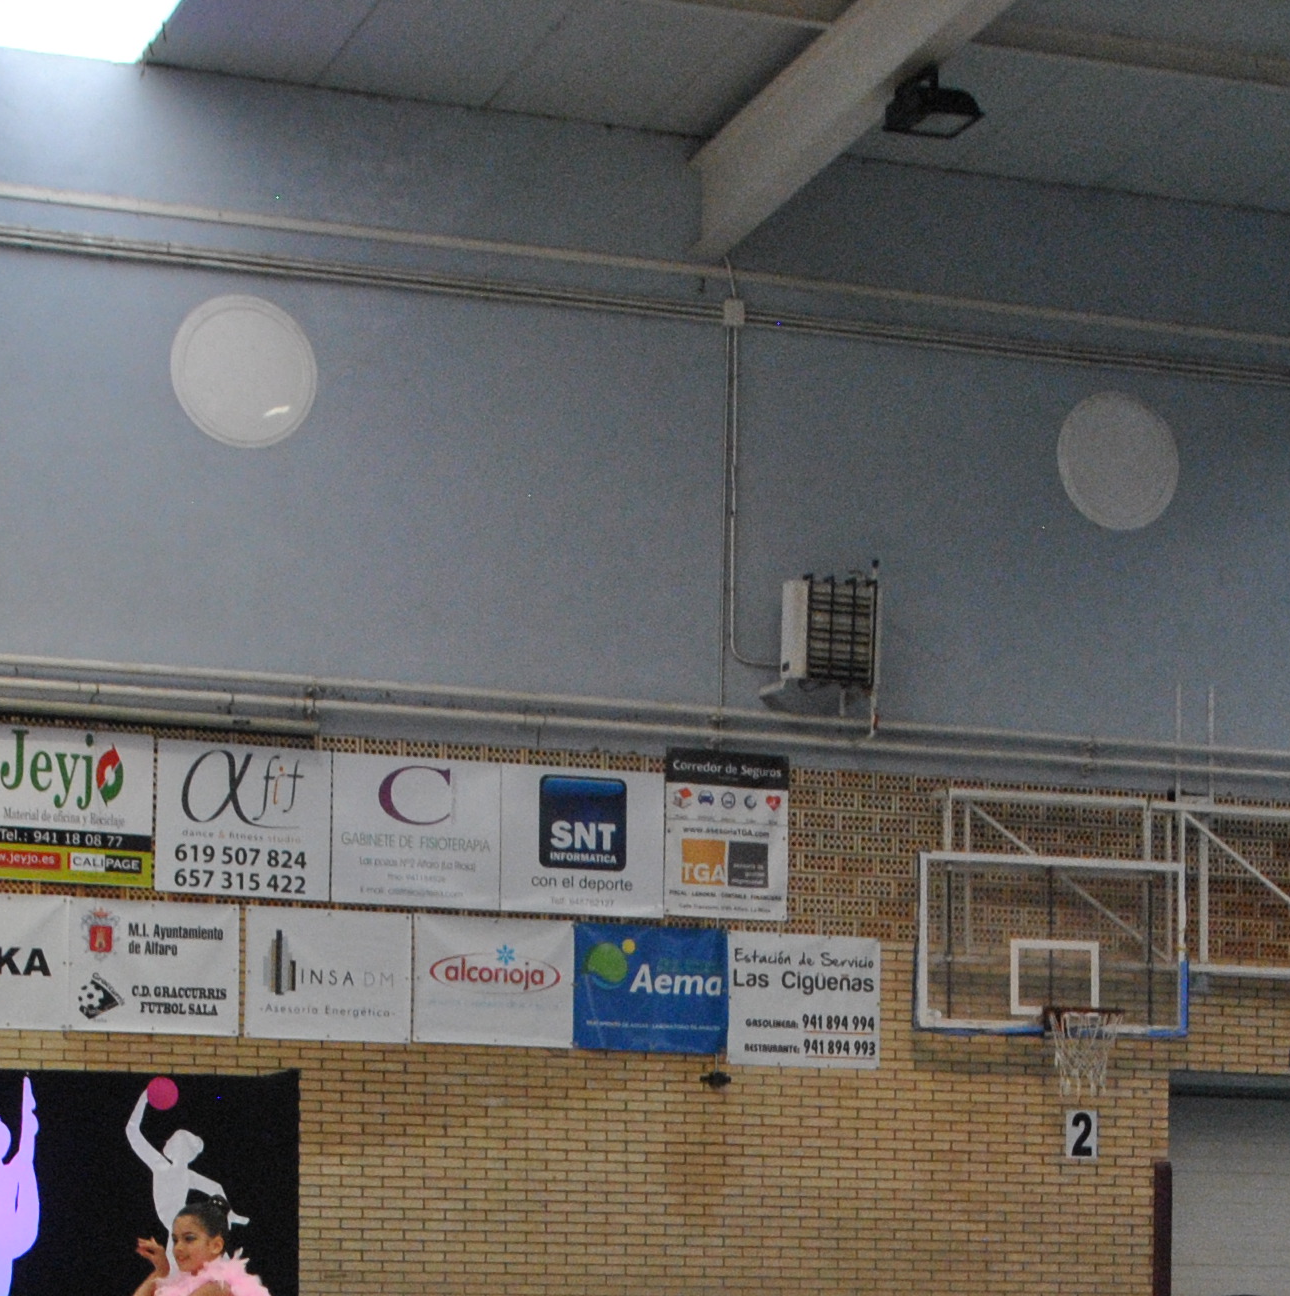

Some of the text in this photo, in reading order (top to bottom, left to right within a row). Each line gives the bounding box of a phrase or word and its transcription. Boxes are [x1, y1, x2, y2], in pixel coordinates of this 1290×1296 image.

[0, 729, 124, 810] Jeyjo
[673, 760, 782, 779] Corredor de Seguros
[3, 806, 38, 822] Material
[41, 810, 51, 822] de
[90, 813, 125, 828] Reciclaje
[34, 830, 57, 844] 941
[65, 833, 80, 845] 18
[85, 834, 101, 846] 08
[107, 835, 123, 847] 77
[341, 831, 491, 852] GABINETE DE FISIOTERAPIA
[550, 820, 616, 851] SNT
[175, 844, 307, 869] 619 507 824
[174, 868, 306, 895] 657 315 422
[683, 862, 727, 883] TGA
[531, 876, 633, 893] con el deporte
[128, 922, 223, 941] M.I. Ayuntamiento
[128, 940, 178, 956] de Alfaro
[734, 948, 874, 969] Estación de Servicio
[630, 963, 722, 996] Aema
[733, 969, 874, 995] Las Cigüeñas
[132, 985, 227, 1000] C.D. GRACCURRIS
[140, 1003, 218, 1016] FUTBOL SALA
[802, 1014, 822, 1029] 941
[826, 1015, 848, 1030] 894
[852, 1016, 874, 1031] 994
[804, 1039, 824, 1054] 941
[828, 1039, 849, 1055] 894
[854, 1040, 875, 1056] 993
[1070, 1111, 1093, 1158] 2
